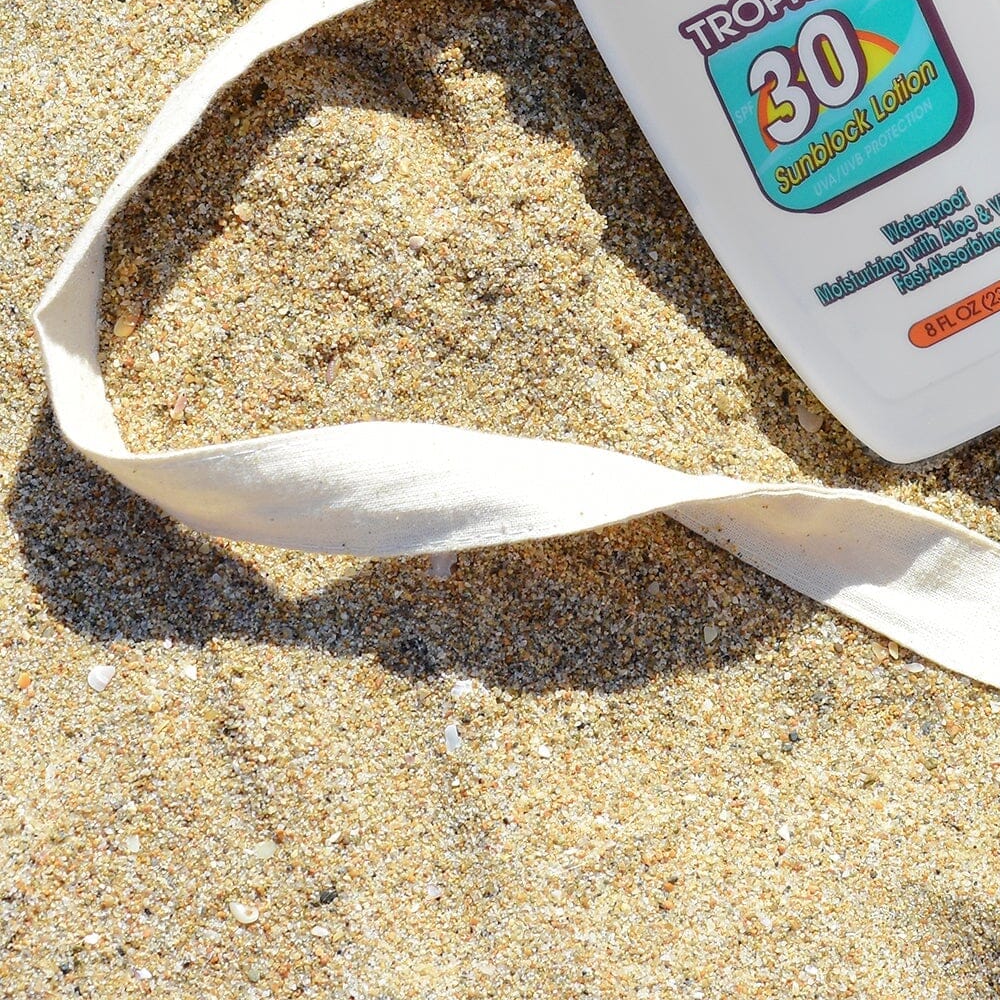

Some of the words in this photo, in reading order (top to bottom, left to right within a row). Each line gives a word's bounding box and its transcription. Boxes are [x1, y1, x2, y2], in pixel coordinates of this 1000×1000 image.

[748, 9, 868, 146] 30
[733, 101, 755, 124] SPF
[773, 107, 873, 194] Sunblock
[868, 58, 939, 123] Lotion
[864, 98, 934, 160] PROTECTION
[880, 185, 971, 245] Waterproof
[813, 249, 909, 307] Moisturizing
[902, 230, 943, 262] with
[938, 212, 979, 246] Aloe
[974, 203, 994, 226] &
[923, 321, 938, 338] 8
[935, 314, 957, 332] FL
[955, 300, 983, 322] OZ
